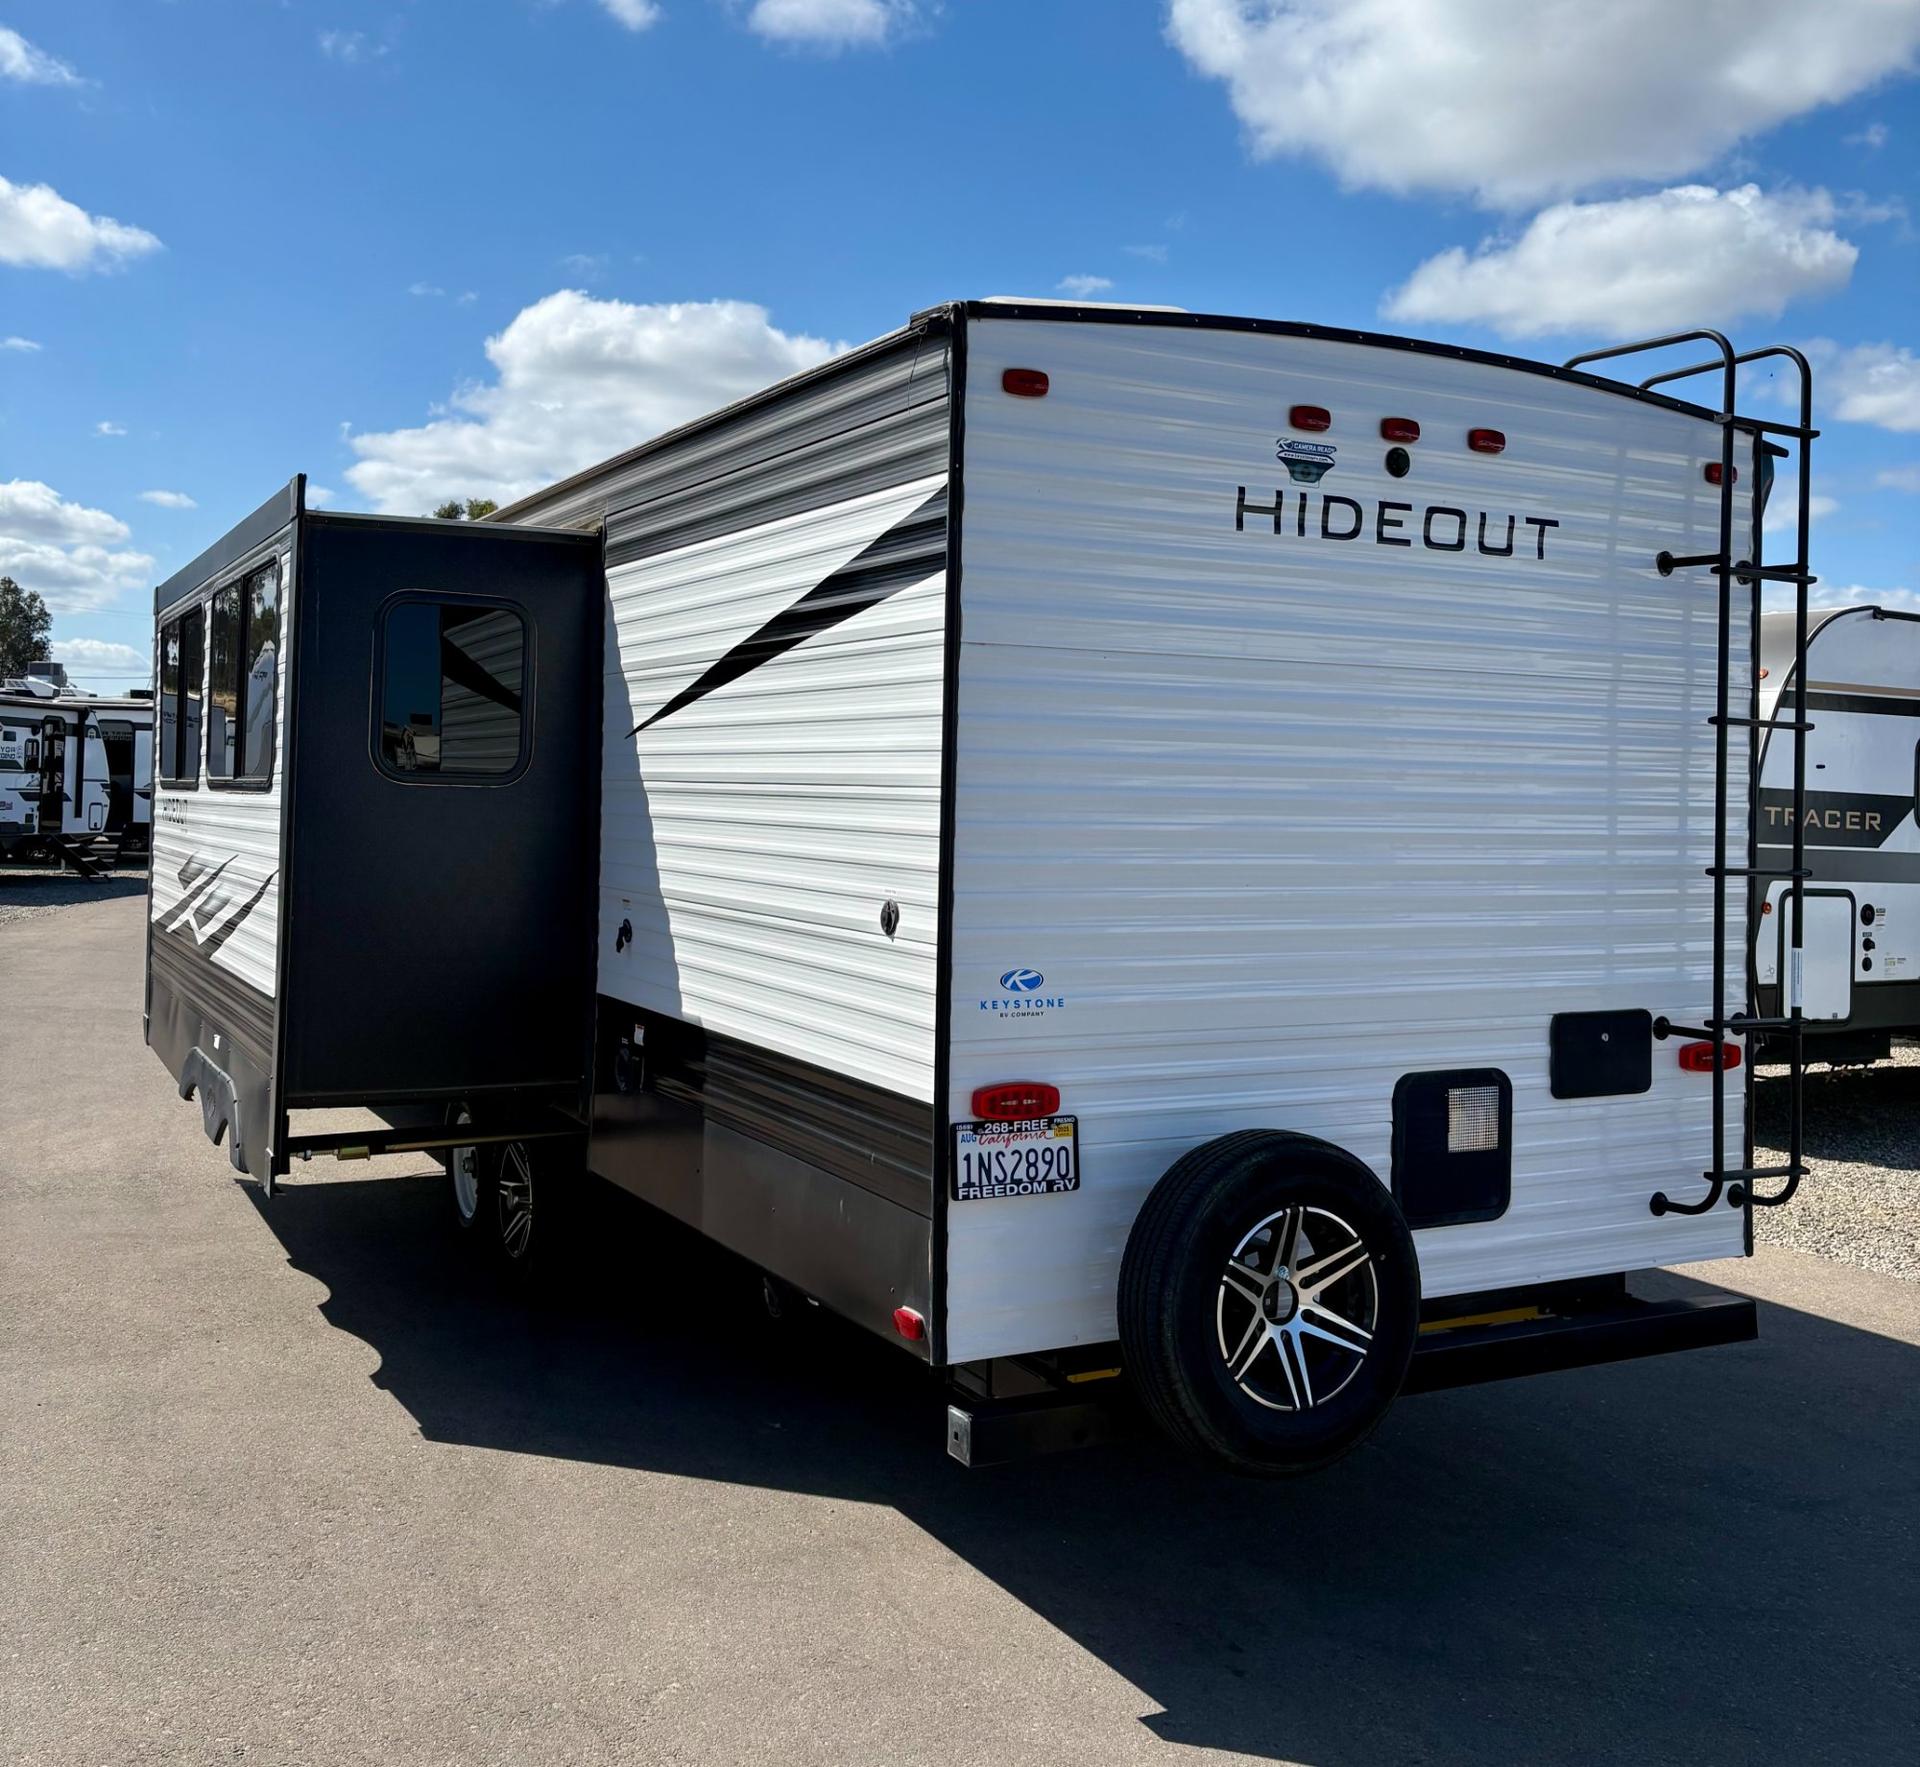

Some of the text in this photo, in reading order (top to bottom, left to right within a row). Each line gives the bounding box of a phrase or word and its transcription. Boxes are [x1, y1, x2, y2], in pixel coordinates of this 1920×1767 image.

[1236, 486, 1560, 560] HIDEOUT
[1763, 806, 1881, 831] TRACER
[980, 998, 1065, 1010] KEYSTONE
[984, 1119, 1049, 1135] 268-FREE
[960, 1134, 977, 1143] AUG
[962, 1146, 1070, 1187] 1NS2890
[958, 1179, 1076, 1200] FREEDOM RV
